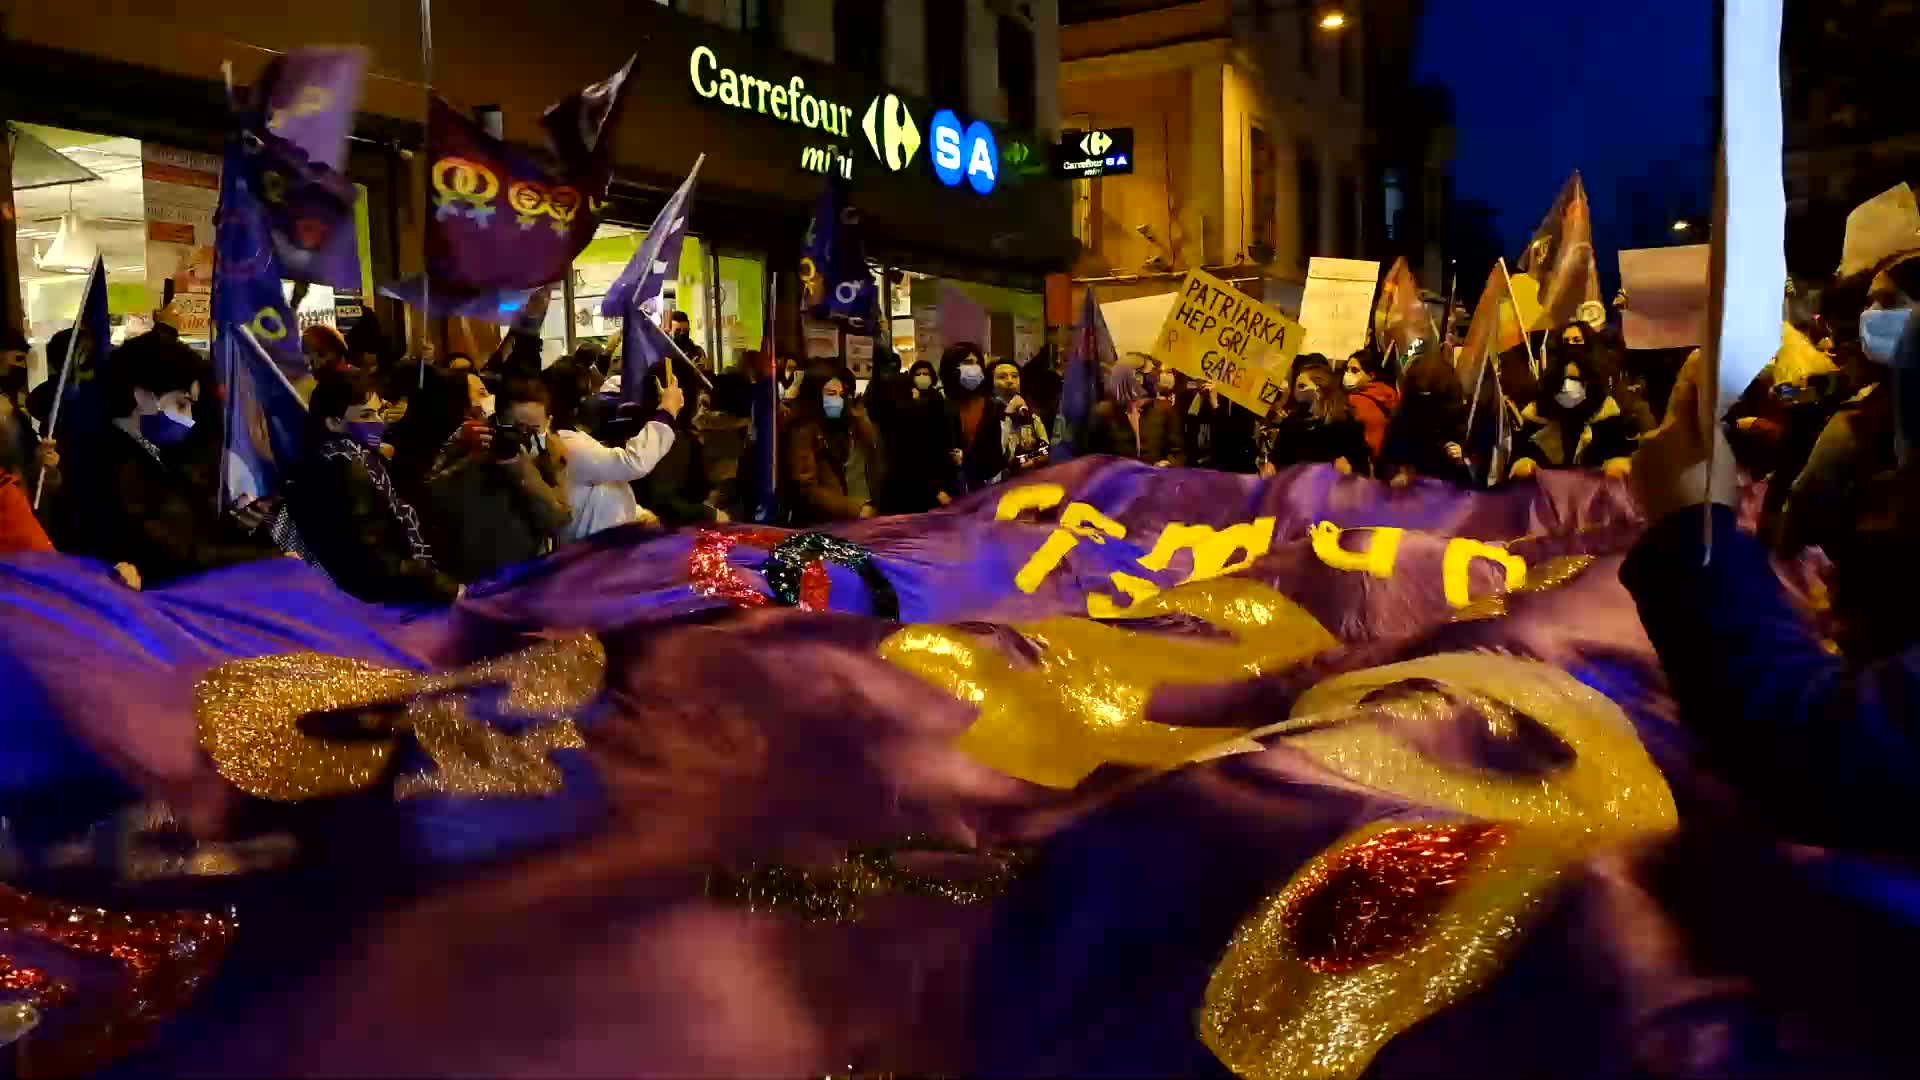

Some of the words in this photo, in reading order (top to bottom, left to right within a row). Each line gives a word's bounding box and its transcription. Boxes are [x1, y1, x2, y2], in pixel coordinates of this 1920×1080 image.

[690, 45, 853, 138] Carrefour
[1176, 302, 1217, 335] HEP
[1185, 277, 1286, 350] PATRIARKA
